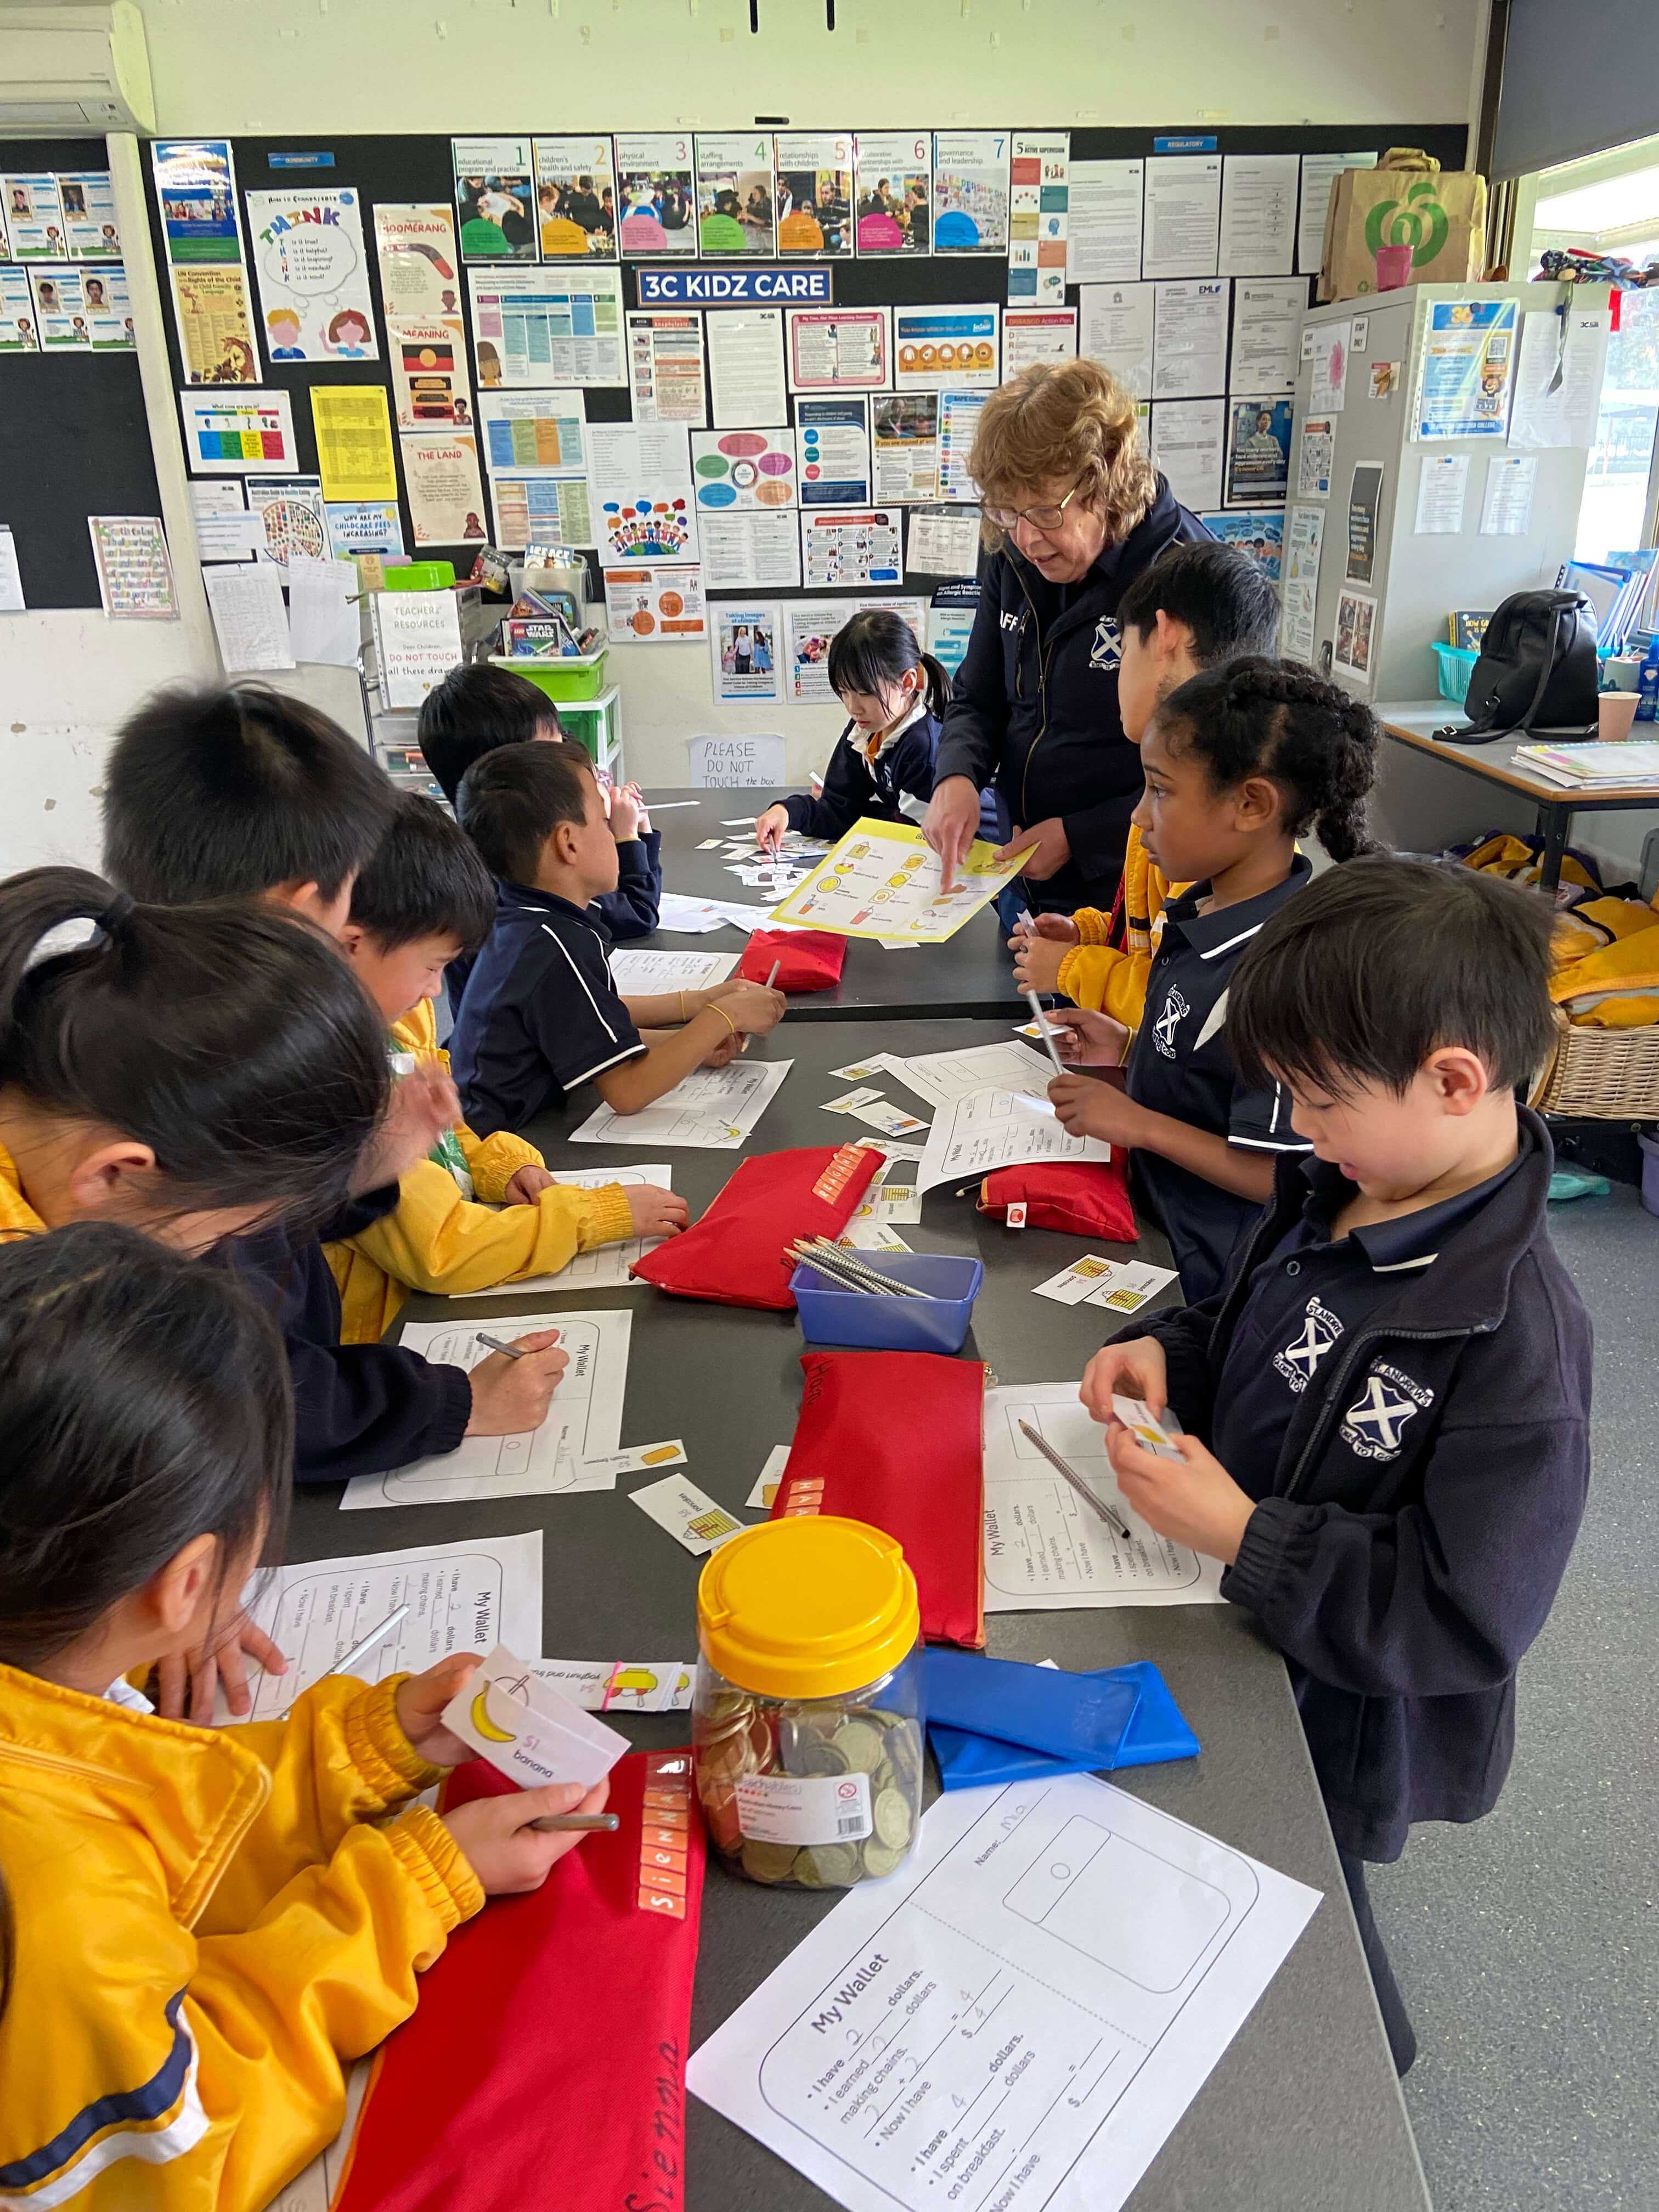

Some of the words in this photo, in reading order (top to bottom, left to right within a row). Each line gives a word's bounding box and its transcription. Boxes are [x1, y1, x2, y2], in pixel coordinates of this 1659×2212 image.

[516, 145, 526, 166] 1
[594, 144, 606, 165] 2
[619, 151, 645, 160] physical
[675, 140, 687, 161] 3
[700, 152, 723, 161] staffing
[754, 141, 766, 161] 4
[834, 140, 846, 160] 5
[914, 140, 925, 159] 6
[993, 139, 1005, 158] 7
[1017, 143, 1024, 154] 5
[496, 166, 521, 174] practice
[573, 164, 592, 172] safety
[951, 157, 983, 166] leadership
[645, 275, 679, 298] 3C
[686, 275, 748, 297] KIDZ
[754, 274, 825, 297] CARE
[1199, 286, 1215, 294] EML
[417, 451, 435, 460] THE
[437, 450, 462, 460] LAND
[335, 522, 373, 530] CHILDCARE
[375, 521, 391, 529] FEES
[343, 529, 387, 539] INCREASING?
[529, 545, 549, 557] ICE
[548, 548, 570, 560] AGE
[394, 619, 445, 629] RESOURCES
[526, 630, 554, 638] WARS
[390, 653, 402, 662] DO
[405, 653, 424, 662] NOT
[428, 652, 458, 661] TOUCH
[388, 667, 399, 675] all
[403, 666, 425, 675] these
[704, 742, 756, 758] PLEASE
[707, 759, 724, 773] DO
[730, 760, 754, 773] NOT
[702, 775, 740, 788] TOUCH
[746, 776, 757, 786] the
[760, 776, 775, 786] box
[1319, 1308, 1343, 1336] ANDRE
[576, 1344, 591, 1356] My
[575, 1356, 589, 1377] Wallet
[1383, 1364, 1433, 1407] ANDREWS
[679, 1492, 703, 1513] pancakes
[984, 1509, 1000, 1541] Wallet
[1026, 1505, 1037, 1526] dollars
[990, 1541, 1006, 1556] My
[1038, 1551, 1050, 1575] earned
[1052, 1554, 1066, 1580] making
[1112, 1554, 1122, 1571] have
[420, 1572, 430, 1598] making
[298, 1594, 311, 1605] Now
[342, 1589, 353, 1609] spent
[417, 1597, 427, 1617] chains.
[474, 1591, 492, 1607] My
[324, 1593, 337, 1626] breakfast.
[473, 1608, 490, 1644] Wallet
[332, 1640, 344, 1664] dollar
[548, 1671, 565, 1680] and
[523, 1734, 540, 1751] $1
[514, 1749, 554, 1779] banana
[974, 1839, 1002, 1867] Name:
[810, 2011, 843, 2035] My
[833, 1953, 890, 2006] Wallet
[812, 2084, 823, 2094] I
[822, 2058, 845, 2084] have
[845, 2028, 864, 2046] 2
[887, 1970, 924, 2007] dollars.
[961, 2028, 974, 2039] $
[973, 2006, 987, 2019] 4
[828, 2096, 838, 2106] I
[835, 2058, 871, 2099] earned
[905, 1980, 938, 2017] dollars
[988, 2033, 1025, 2074] dollars.
[840, 2080, 880, 2125] making
[873, 2046, 909, 2089] chains.
[879, 2112, 907, 2141] Now
[902, 2104, 911, 2114] I
[908, 2080, 932, 2108] have
[951, 2092, 967, 2109] 4
[1067, 2096, 1081, 2109] $
[932, 2169, 944, 2180] I
[939, 2137, 970, 2174] spent
[1004, 2050, 1036, 2087] dollars
[919, 2129, 949, 2162] have
[915, 2156, 926, 2166] I
[946, 2182, 964, 2201] on
[957, 2128, 1007, 2186] breakfast.
[1013, 2153, 1041, 2186] have
[1011, 2180, 1020, 2191] I
[988, 2187, 1015, 2212] Now
